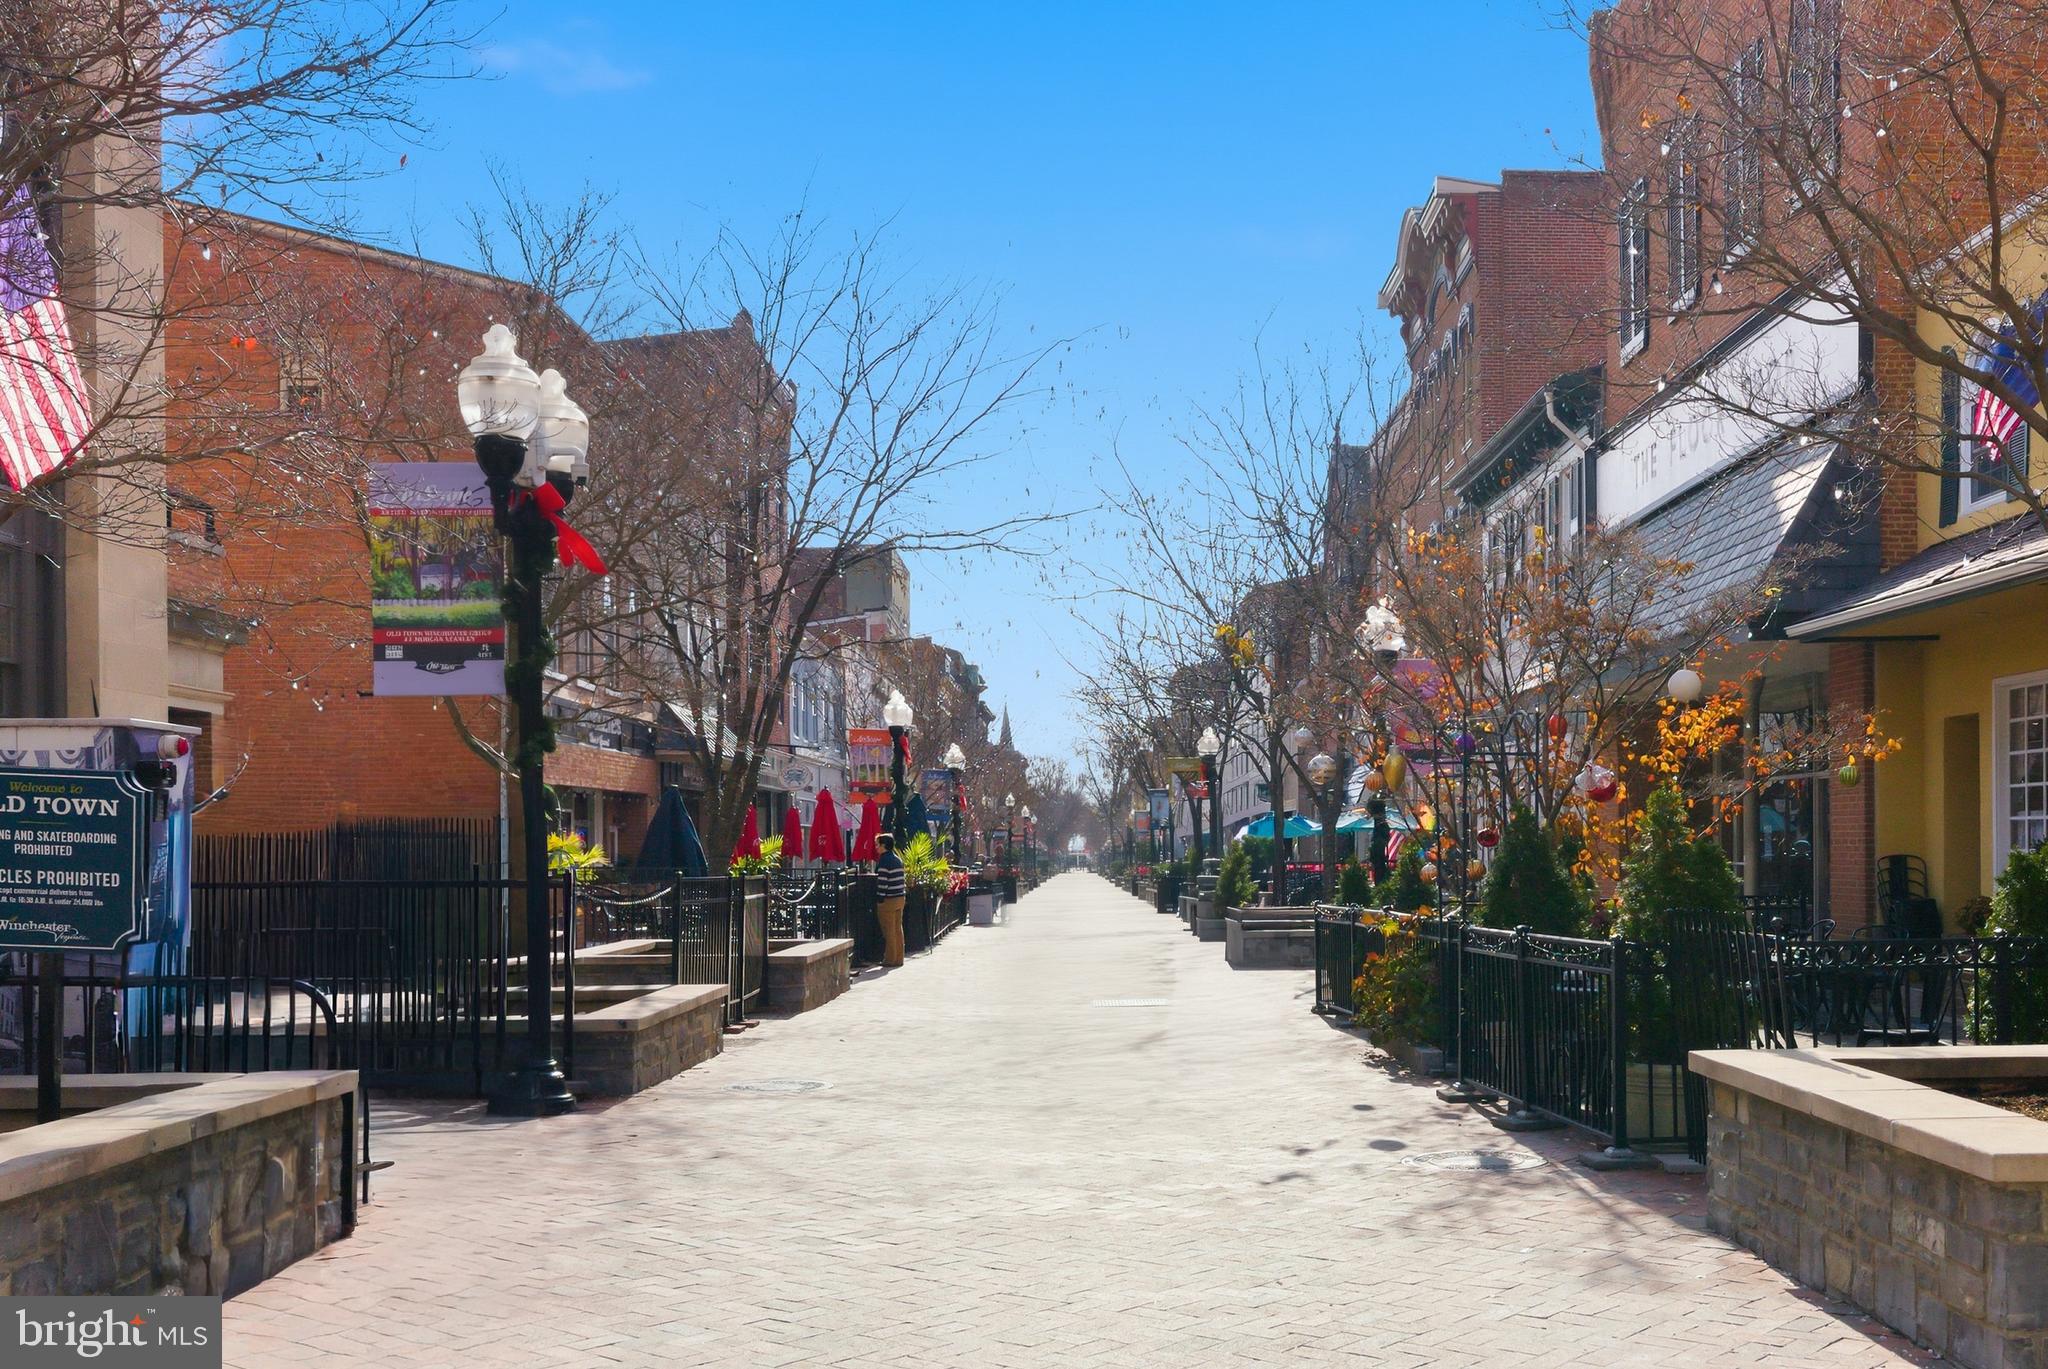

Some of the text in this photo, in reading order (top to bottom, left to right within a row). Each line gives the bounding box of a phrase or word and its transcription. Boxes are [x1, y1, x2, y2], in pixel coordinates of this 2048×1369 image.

[1631, 441, 1657, 489] THE
[9, 781, 83, 793] Welcome to
[33, 797, 120, 817] TOWN
[14, 830, 35, 841] AND
[37, 831, 117, 845] SKATEBOARDING
[14, 844, 73, 856] PROHIBITED
[37, 870, 120, 887] PROHIBITED
